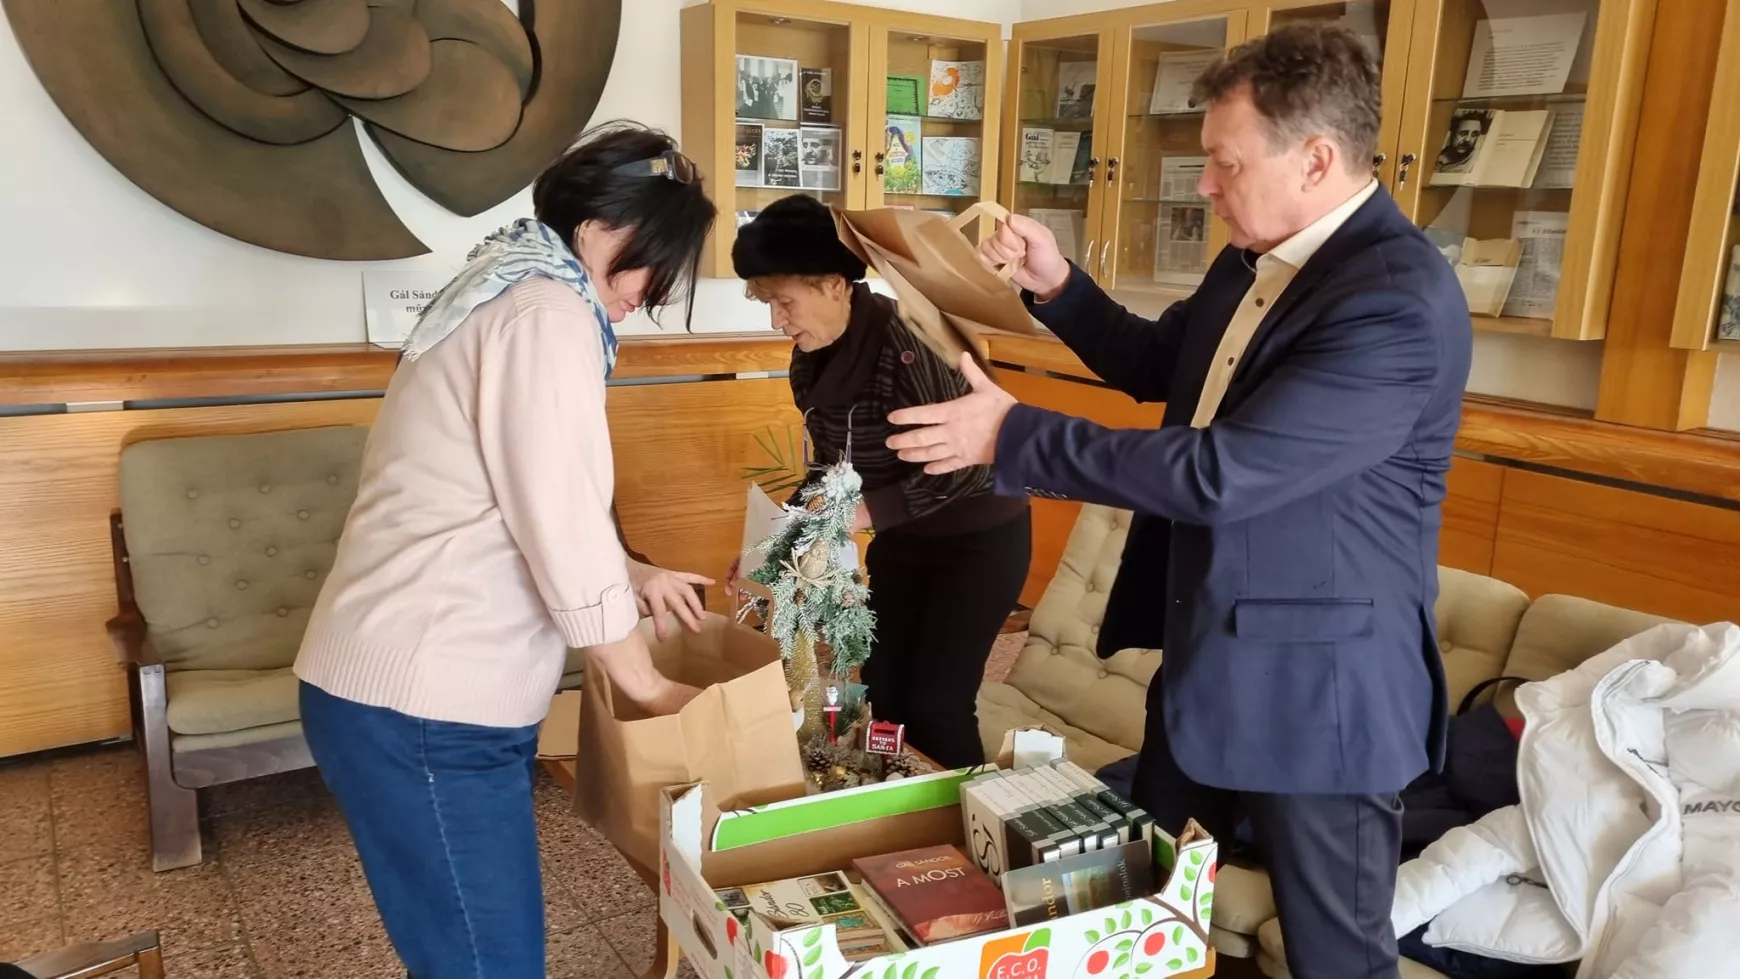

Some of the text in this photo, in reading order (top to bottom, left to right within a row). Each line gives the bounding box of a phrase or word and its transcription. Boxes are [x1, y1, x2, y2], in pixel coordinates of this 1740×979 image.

[390, 290, 438, 299] Gál Sánd
[406, 304, 424, 312] mű
[897, 867, 966, 888] A MOST
[785, 902, 809, 917] 80
